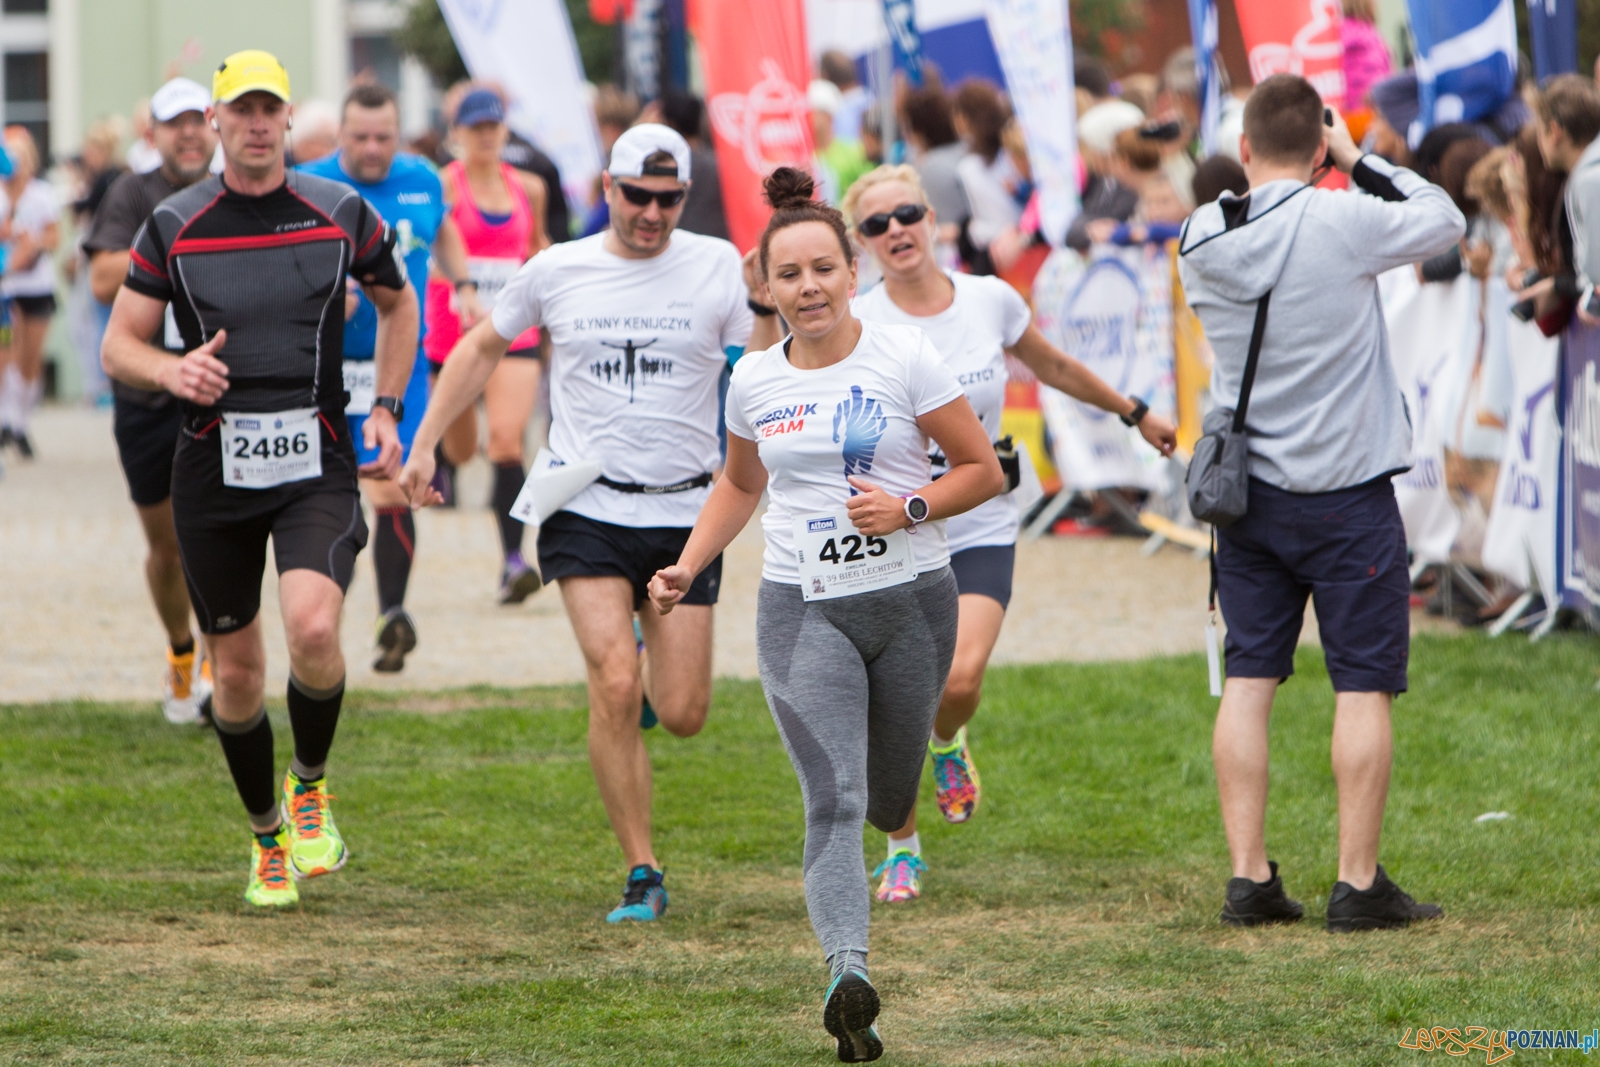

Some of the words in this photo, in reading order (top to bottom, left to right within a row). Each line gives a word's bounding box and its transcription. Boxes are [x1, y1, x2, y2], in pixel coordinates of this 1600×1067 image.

[573, 316, 620, 331] SŁYNNY
[623, 316, 692, 331] KENIJCZYK
[761, 418, 805, 438] TEAM
[233, 432, 309, 460] 2486
[818, 534, 888, 564] 425
[826, 574, 837, 583] 39
[839, 570, 860, 581] BIEG
